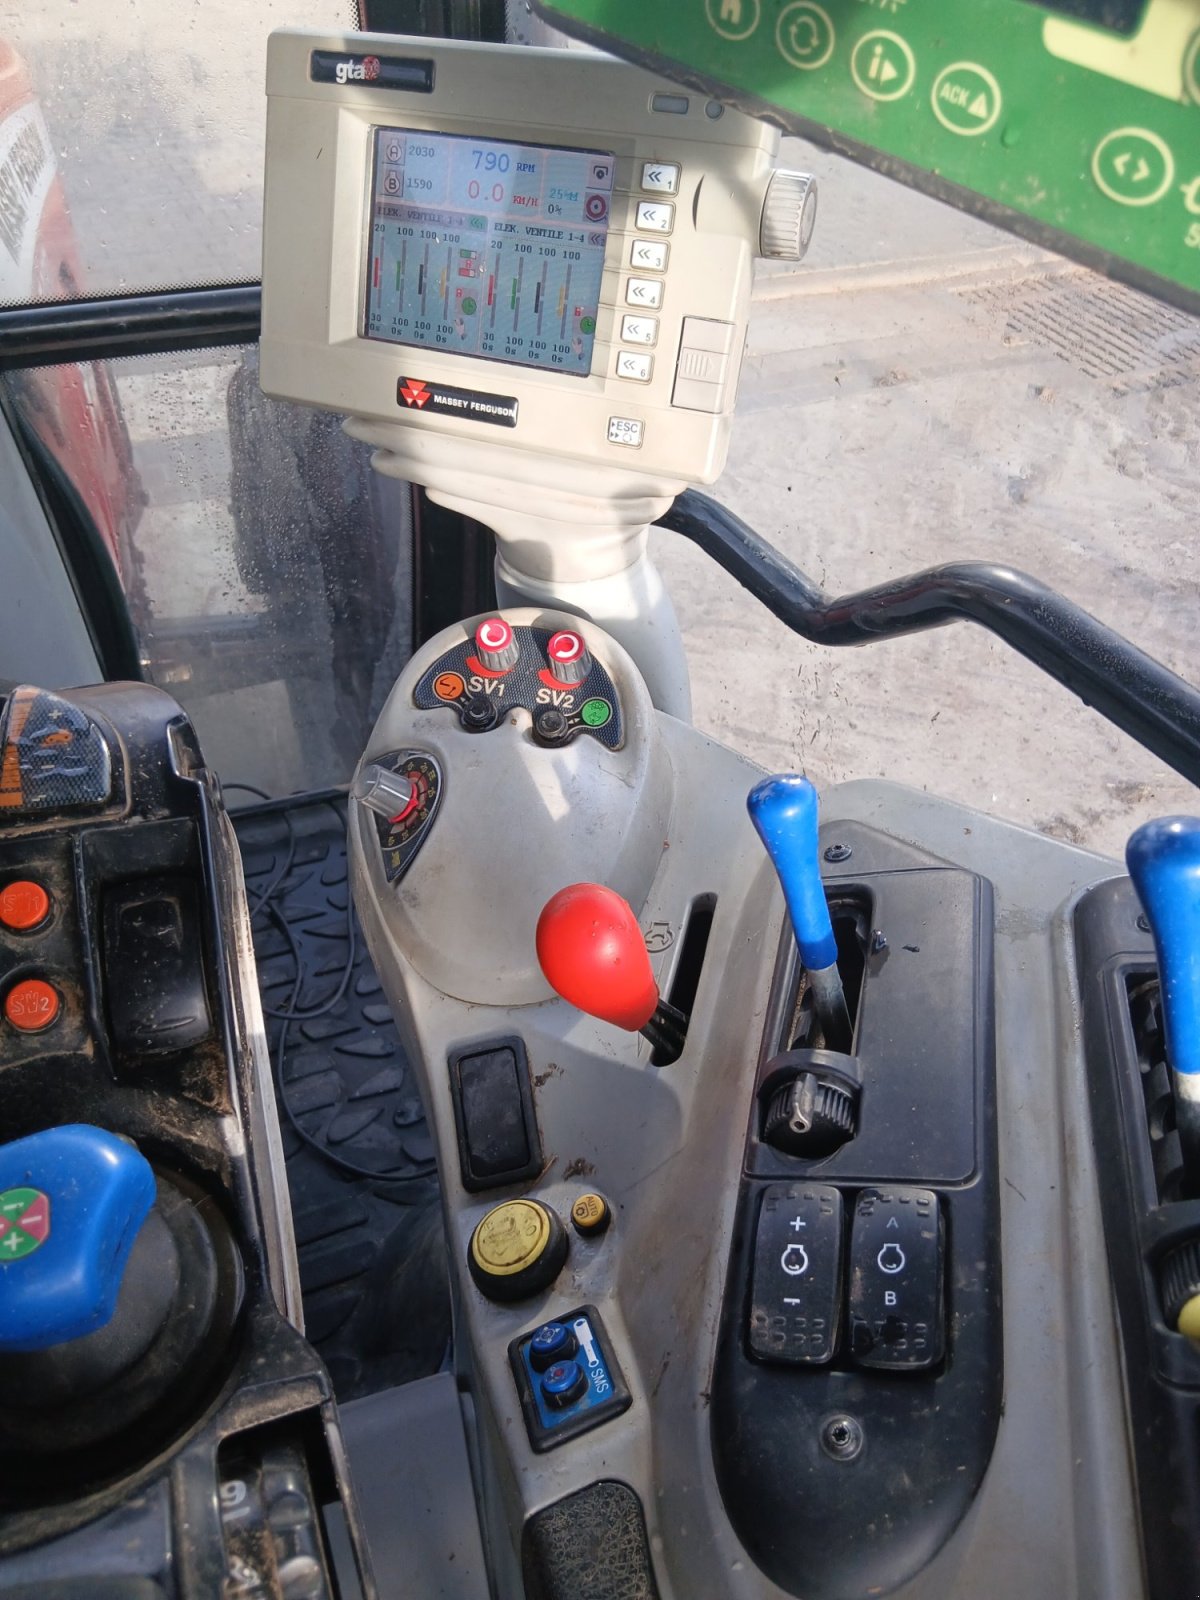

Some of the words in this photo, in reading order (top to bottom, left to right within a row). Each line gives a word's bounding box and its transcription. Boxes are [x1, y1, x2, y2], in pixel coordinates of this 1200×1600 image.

[940, 81, 970, 108] ACK
[409, 145, 435, 158] 2030
[472, 150, 510, 173] 790
[516, 162, 536, 173] RPM
[407, 178, 433, 190] 1590
[468, 180, 504, 202] 0.0
[667, 181, 673, 190] 1
[374, 224, 386, 233] 20
[397, 227, 414, 237] 100
[421, 230, 437, 240] 100
[443, 233, 460, 243] 100
[494, 222, 519, 234] ELEK.
[525, 226, 564, 240] VENTILE
[568, 233, 585, 243] 1-4
[660, 219, 667, 229] 2
[491, 240, 503, 250] 20
[515, 243, 532, 253] 100
[539, 247, 556, 257] 100
[563, 250, 581, 260] 100
[655, 258, 662, 267] 3
[391, 317, 409, 327] 100
[414, 321, 431, 331] 100
[437, 325, 453, 335] 100
[484, 332, 495, 341] 30
[506, 336, 524, 346] 100
[529, 340, 546, 350] 100
[551, 344, 571, 354] 100
[433, 395, 469, 408] MASSEY
[470, 402, 515, 417] FERGUSON
[616, 421, 638, 434] ESC
[468, 676, 506, 697] SV1
[535, 688, 575, 709] SV2
[586, 1196, 599, 1217] AUTO
[886, 1216, 899, 1229] A
[884, 1290, 897, 1306] B
[591, 1368, 609, 1393] SMS
